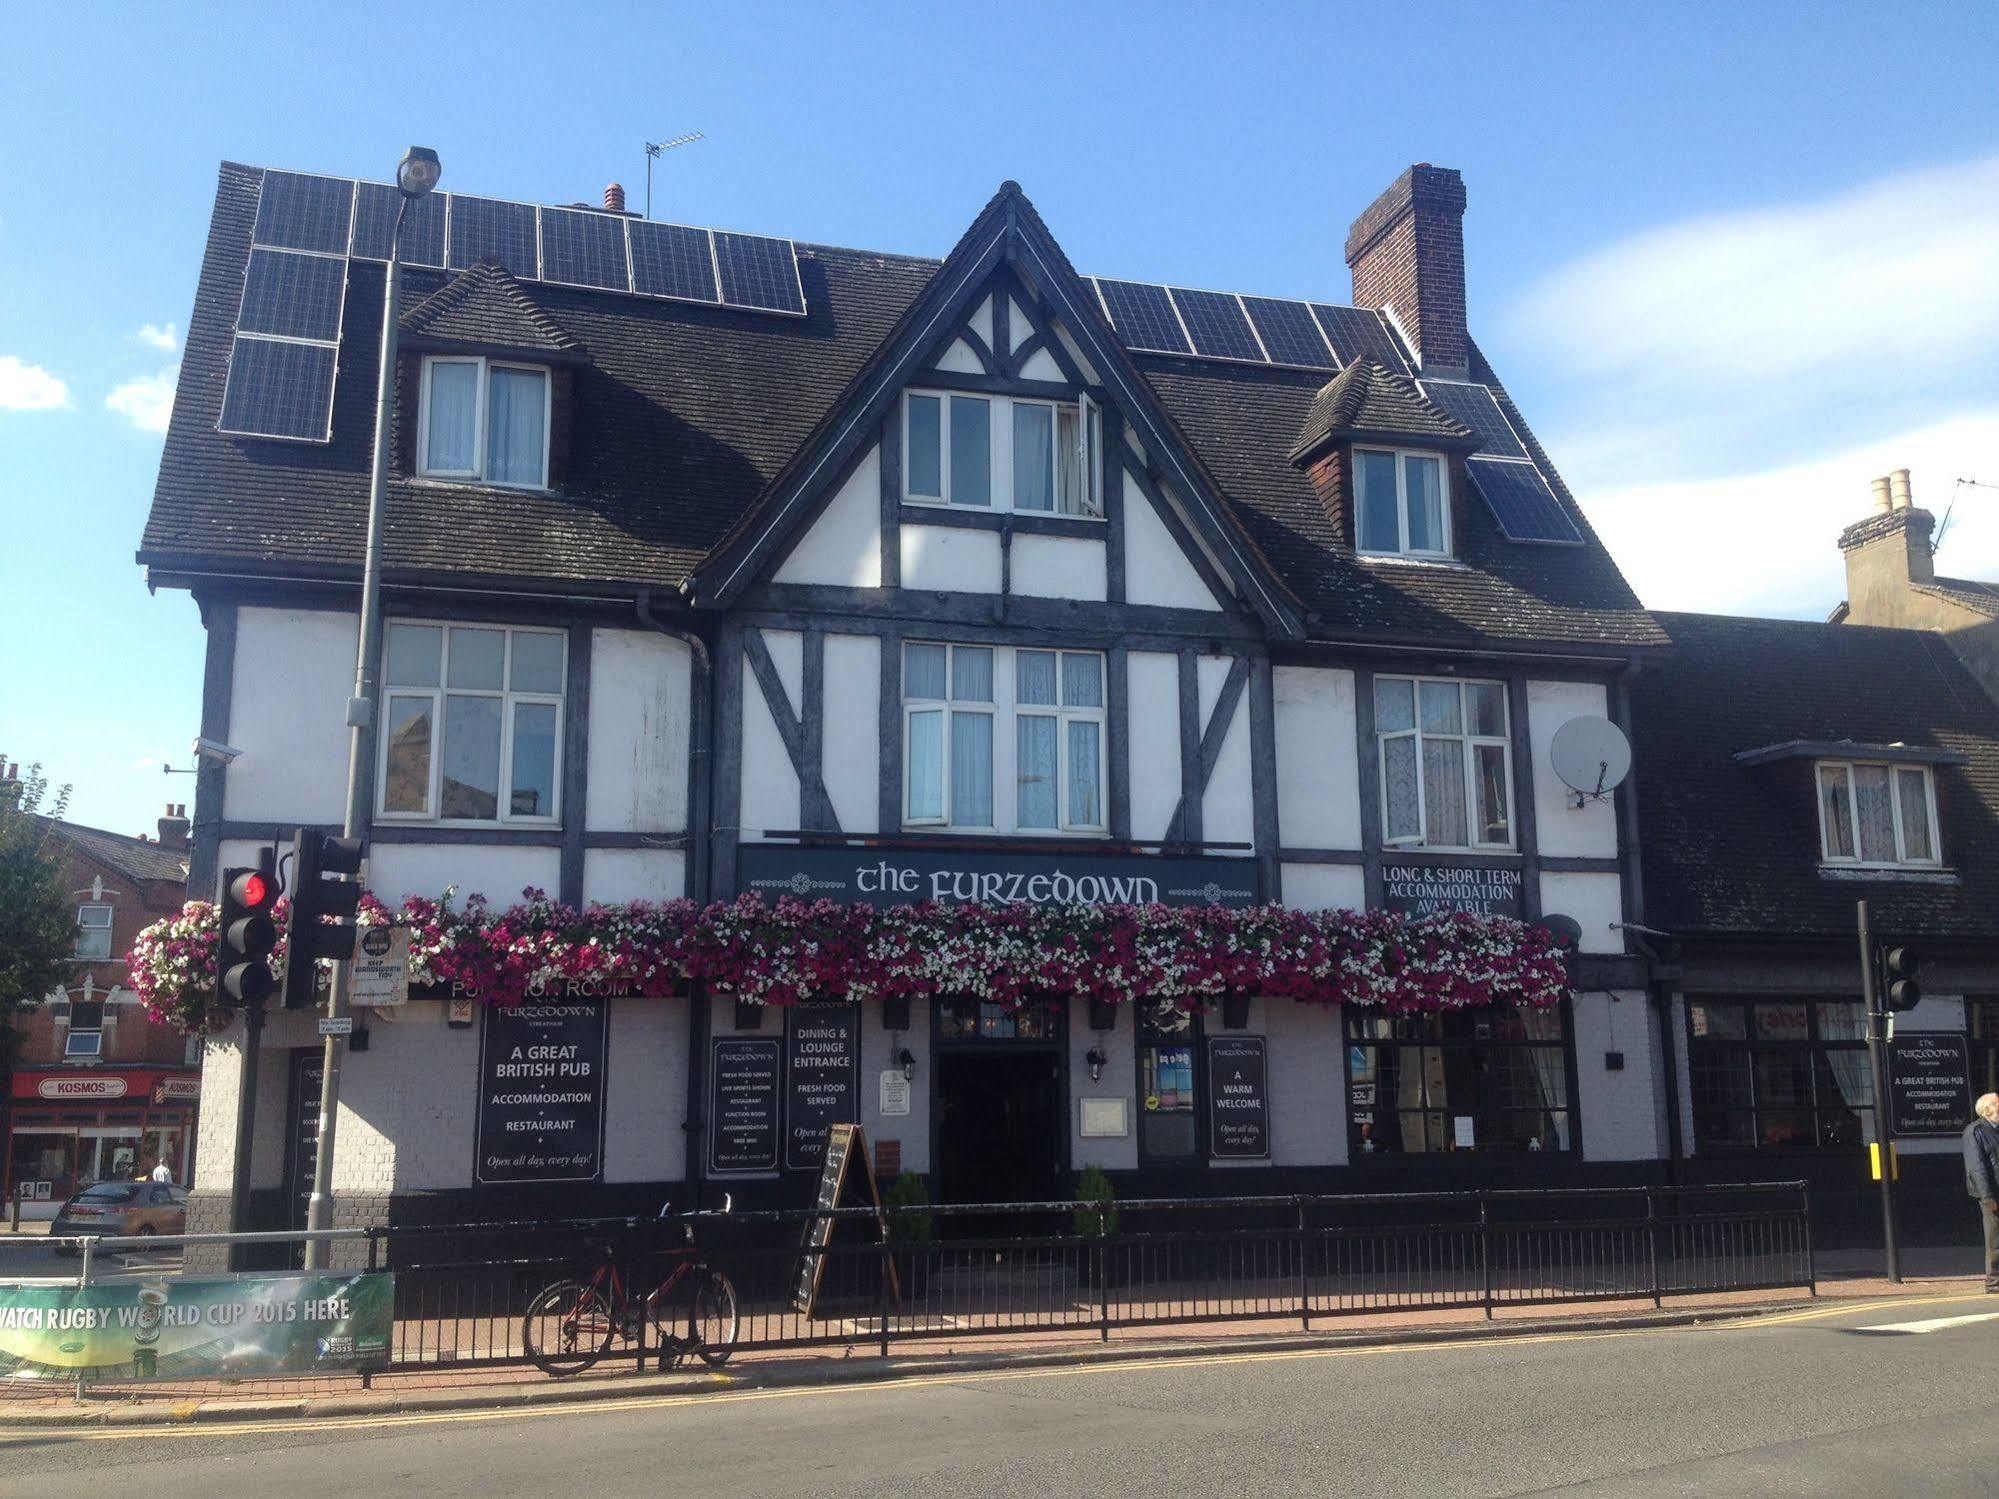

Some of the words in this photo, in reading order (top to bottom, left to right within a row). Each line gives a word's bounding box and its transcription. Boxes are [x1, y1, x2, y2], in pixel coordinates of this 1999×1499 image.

[1383, 866, 1421, 882] LONG
[1424, 868, 1434, 882] &
[1436, 868, 1482, 884] SHORT
[1485, 869, 1521, 885] TERM
[856, 861, 919, 893] the
[929, 869, 1158, 904] FURZEDOWN
[1389, 883, 1514, 900] ACCOMMODATION
[567, 980, 629, 997] ROOM
[798, 1029, 836, 1039] DINING
[839, 1028, 847, 1038] &
[511, 1047, 522, 1060] A
[528, 1046, 578, 1059] GREAT
[800, 1043, 844, 1053] LOUNGE
[794, 1056, 849, 1067] ENTRANCE
[496, 1063, 555, 1078] BRITISH
[560, 1062, 591, 1076] PUB
[1234, 1071, 1241, 1079] A
[1894, 1077, 1901, 1085] A
[1902, 1077, 1924, 1085] GREAT
[1925, 1077, 1950, 1085] BRITISH
[57, 1083, 106, 1093] KOSMOS
[798, 1084, 822, 1092] FRESH
[823, 1084, 846, 1092] FOOD
[1223, 1085, 1253, 1094] WARM
[491, 1092, 592, 1104] ACCOMMODATION
[807, 1096, 836, 1105] SERVED
[1216, 1099, 1261, 1108] WELCOME
[506, 1120, 575, 1131] RESTAURANT
[794, 1127, 817, 1140] Open
[800, 1143, 822, 1154] every
[487, 1155, 511, 1169] Open
[513, 1154, 526, 1165] all
[548, 1156, 570, 1167] every
[572, 1153, 592, 1167] day!
[47, 1306, 110, 1330] RUGBY
[207, 1303, 244, 1327] CUP
[253, 1301, 297, 1323] 2015
[304, 1299, 350, 1321] HERE
[331, 1336, 352, 1344] RUGBY
[330, 1346, 353, 1354] 2015
